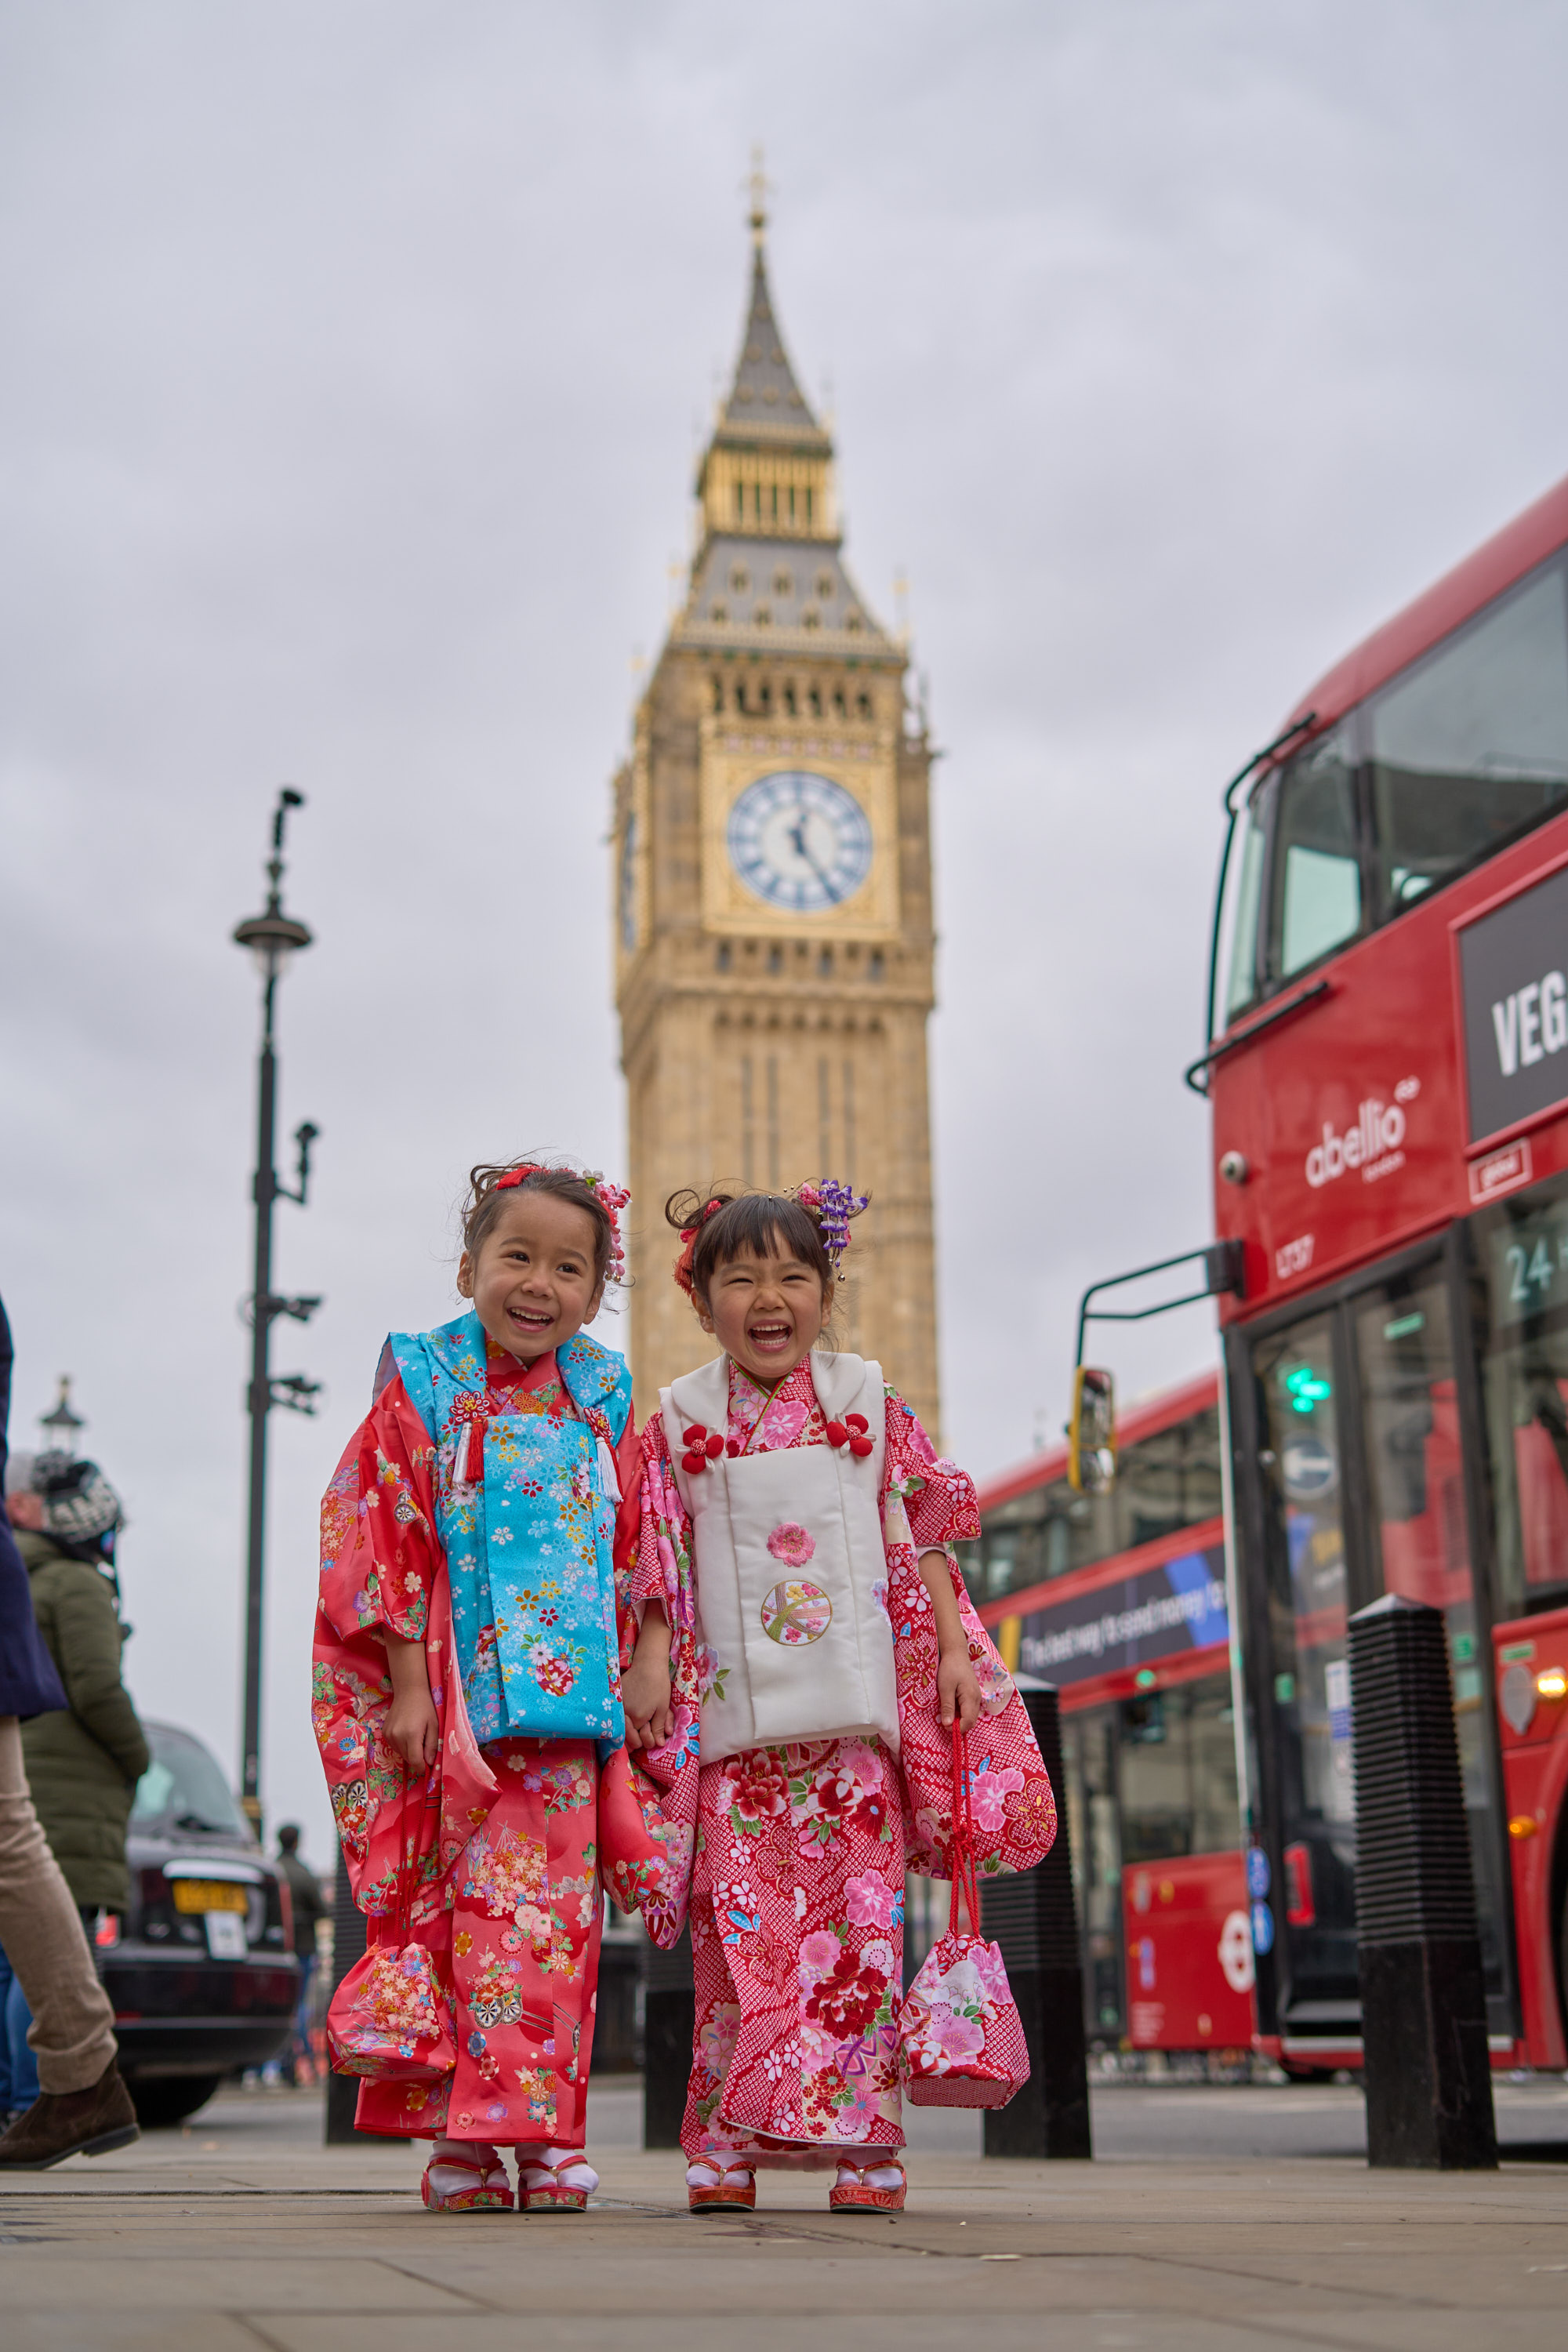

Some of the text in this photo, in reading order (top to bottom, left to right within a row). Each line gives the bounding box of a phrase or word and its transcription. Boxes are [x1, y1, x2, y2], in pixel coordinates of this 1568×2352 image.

[1491, 969, 1568, 1078] VEG
[1305, 1097, 1406, 1189] abellio
[1505, 1235, 1555, 1302] 24
